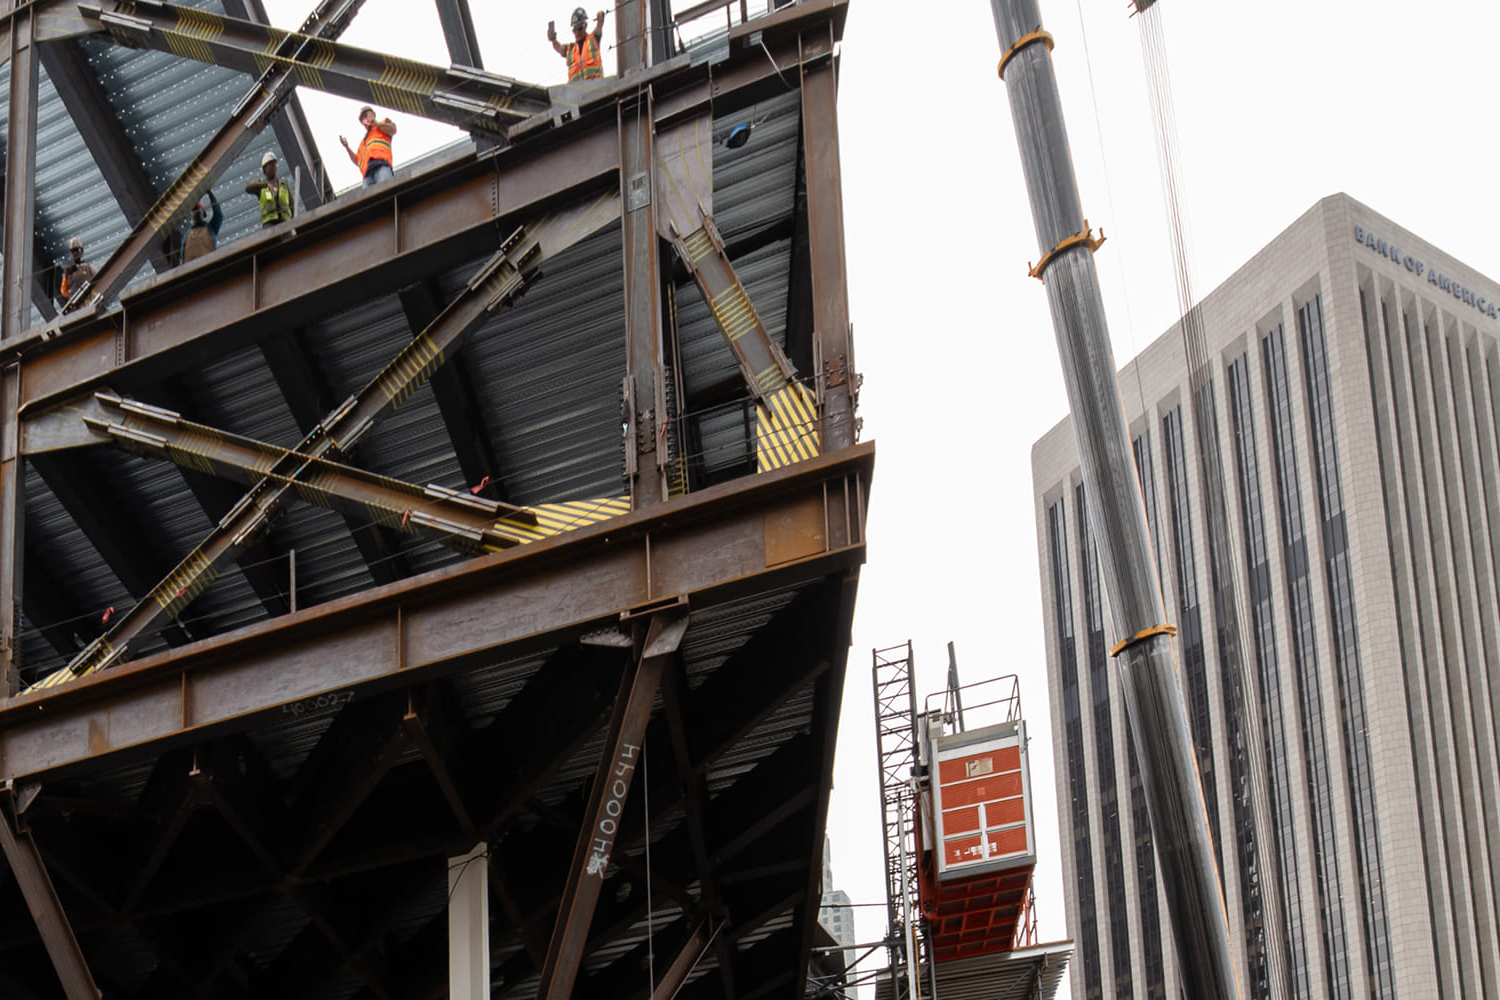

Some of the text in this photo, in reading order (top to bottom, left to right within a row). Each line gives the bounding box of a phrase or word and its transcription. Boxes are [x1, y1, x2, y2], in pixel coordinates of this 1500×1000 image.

[1355, 225, 1498, 320] BANK OF AMERICA
